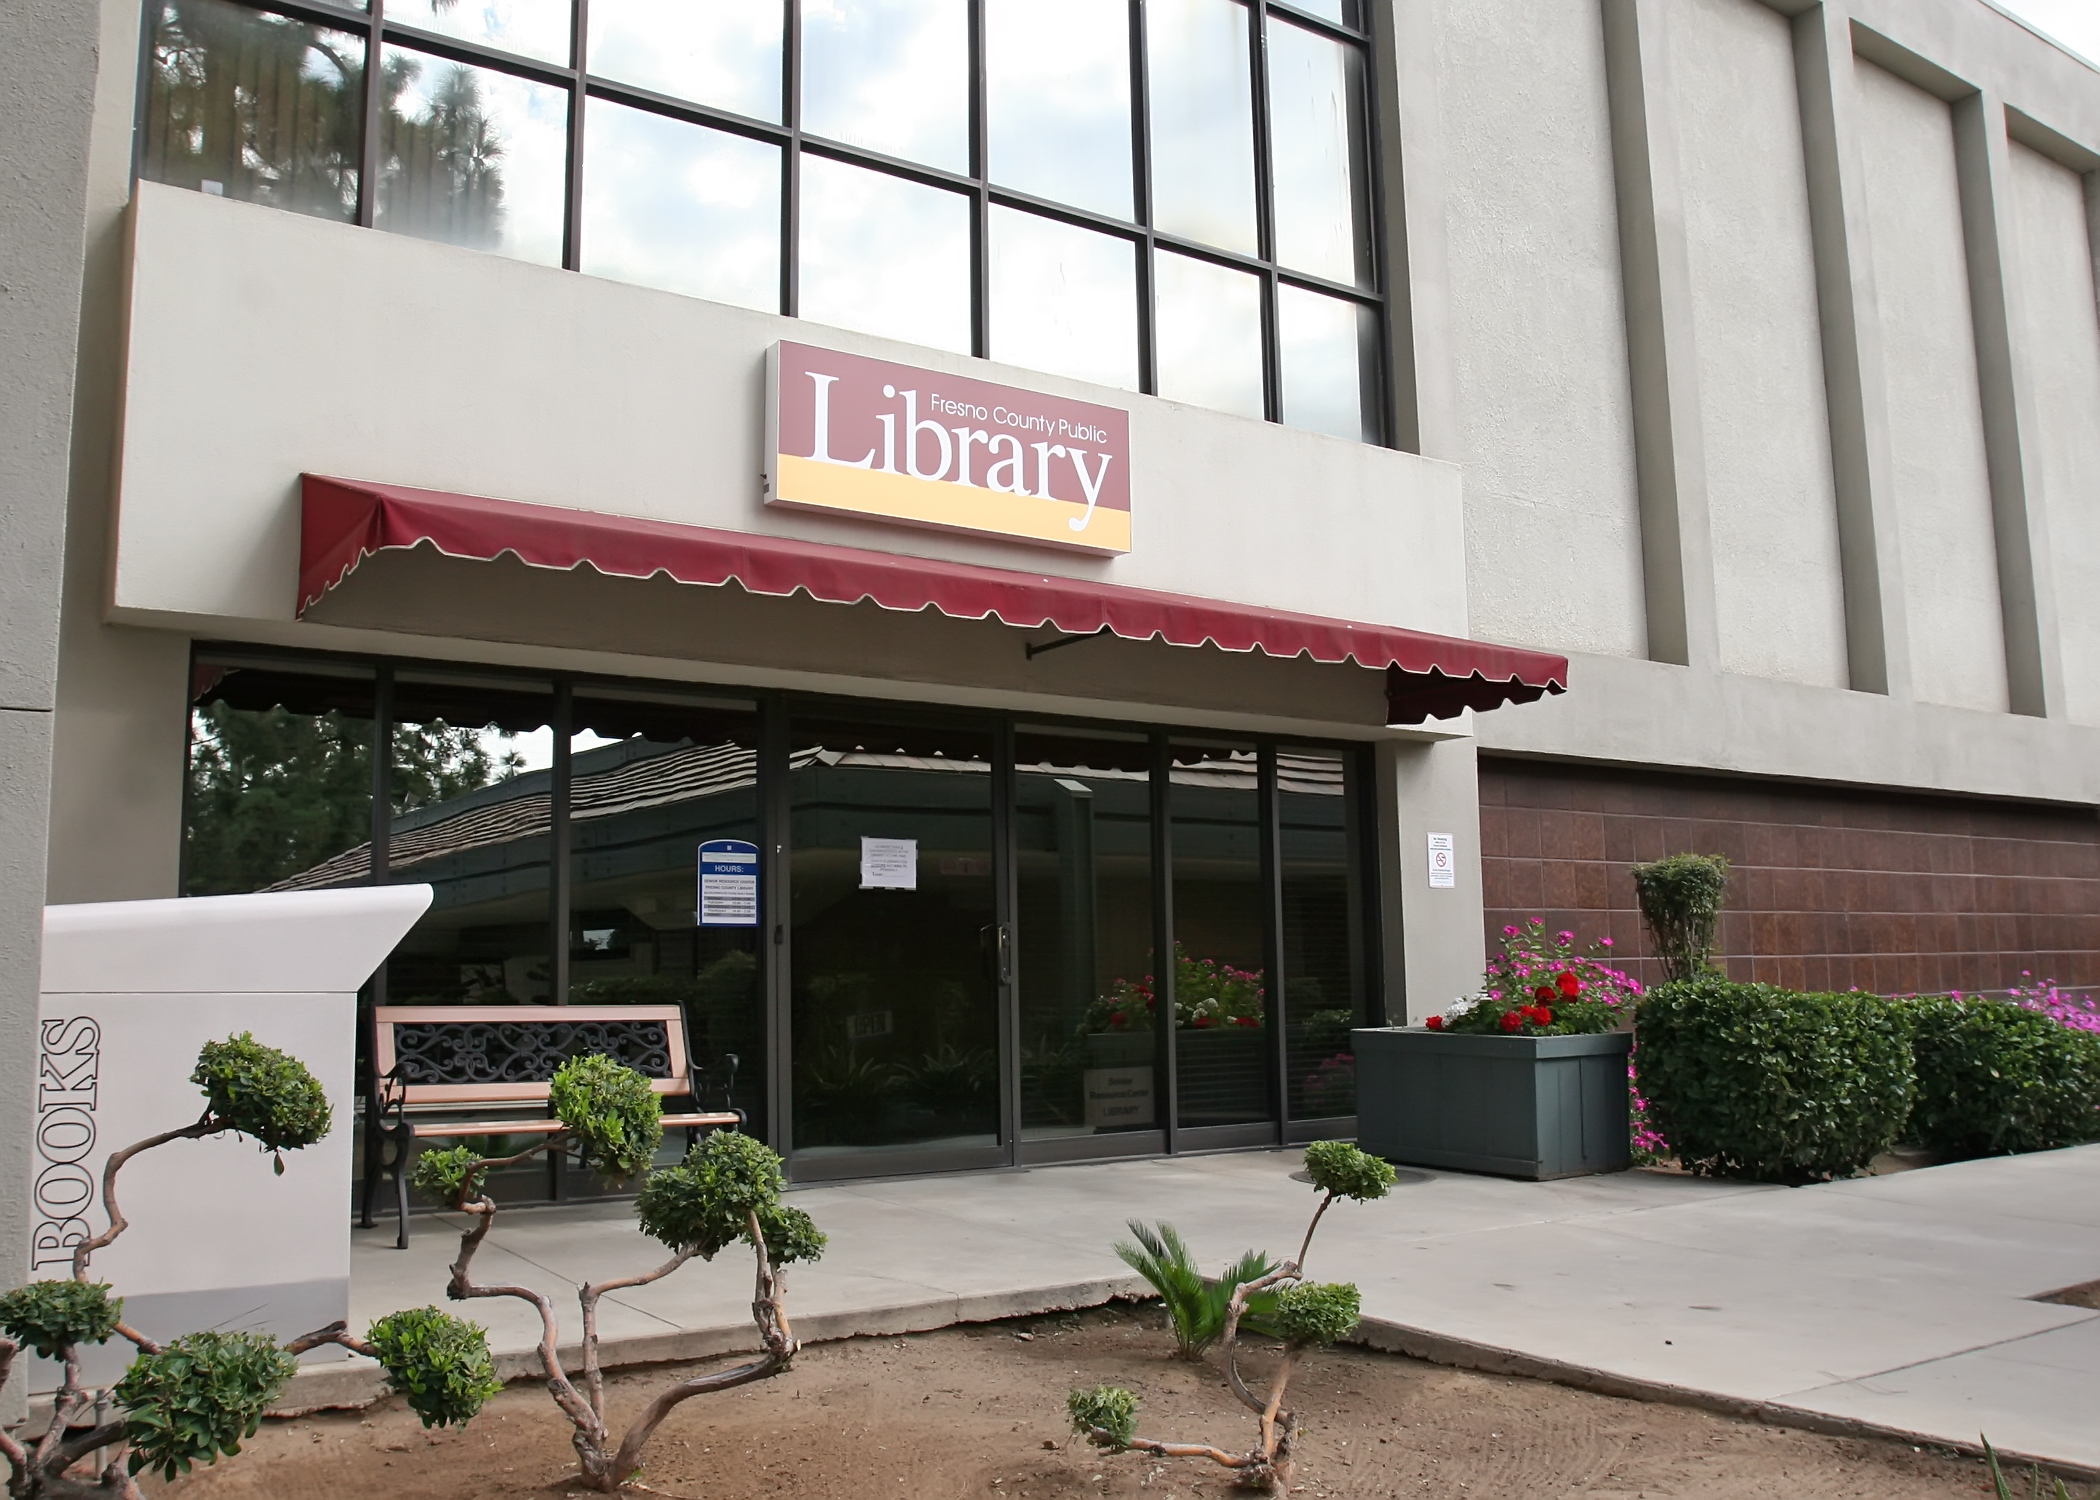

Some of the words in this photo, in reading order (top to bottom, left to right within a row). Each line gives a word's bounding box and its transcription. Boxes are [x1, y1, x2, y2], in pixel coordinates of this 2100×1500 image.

[930, 393, 988, 421] Fresno
[993, 406, 1056, 437] County
[1058, 418, 1108, 445] Public
[803, 370, 1113, 532] Library
[714, 864, 744, 873] HOURS:
[1103, 1105, 1140, 1116] LIBRARY
[31, 1016, 101, 1271] BOOKS
